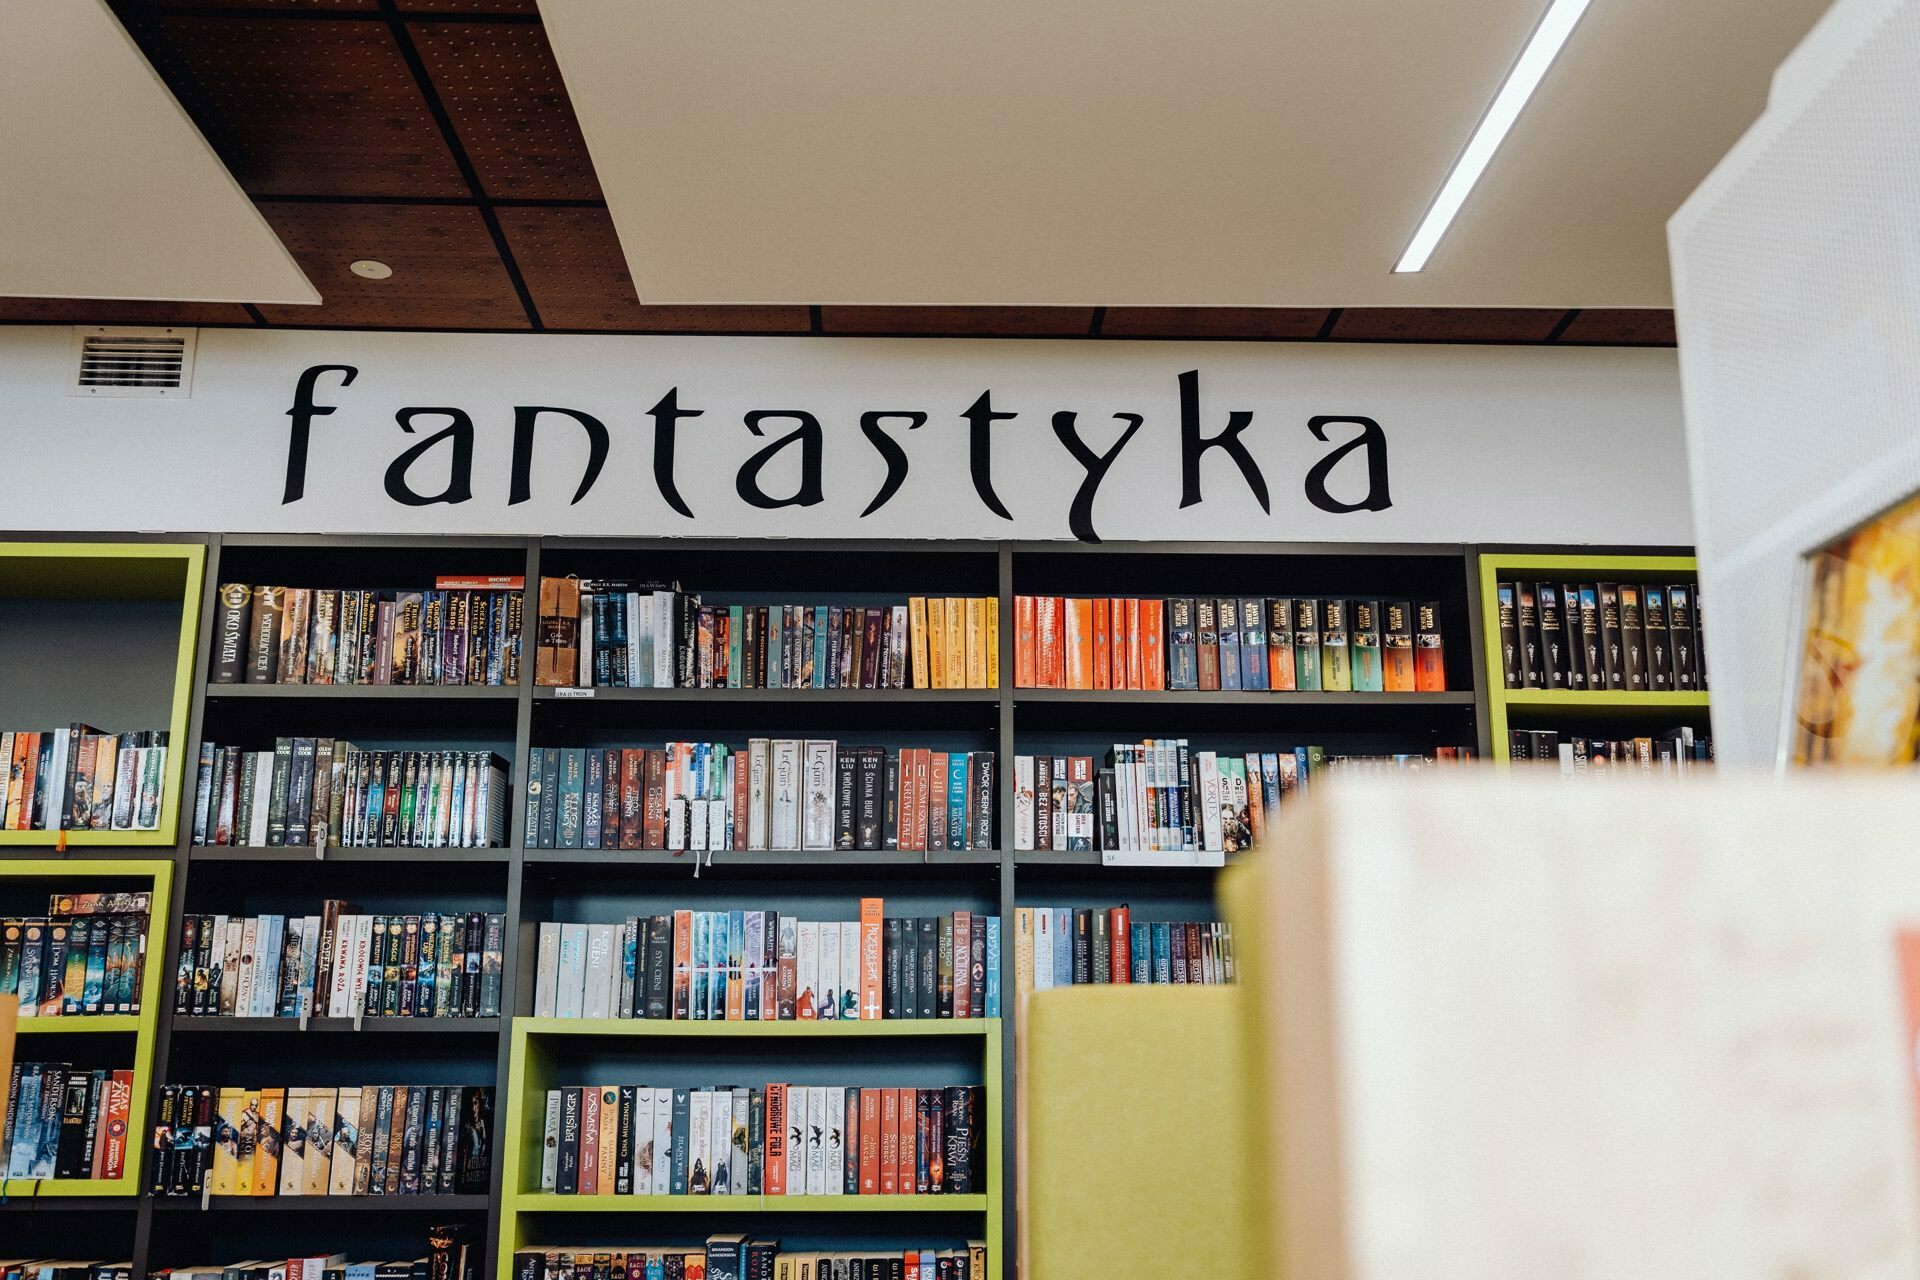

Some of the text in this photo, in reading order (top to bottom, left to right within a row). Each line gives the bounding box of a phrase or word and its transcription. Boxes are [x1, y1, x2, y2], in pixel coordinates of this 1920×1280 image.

[281, 364, 1393, 544] fantastyka
[432, 600, 441, 630] KORONA
[449, 596, 458, 631] NIEBIOS
[457, 600, 466, 627] OGNIE
[472, 595, 481, 636] SZTYLETÓW
[478, 601, 488, 630] ŚCIEŻKA
[222, 610, 241, 663] OKO ŚWIATA
[361, 656, 369, 677] Jordan
[830, 640, 838, 679] PIERWORODNY
[570, 792, 578, 828] KLUCZ
[841, 772, 853, 829] KRÓLOWIE DARY
[864, 772, 876, 818] ŚCIANA BURZ
[903, 781, 912, 811] KREW
[1207, 779, 1218, 822] VORTEX
[1039, 792, 1048, 837] BEZ LITOŚCI
[319, 930, 333, 973] EPOPEJA
[356, 941, 366, 975] KRÓLOWIE
[373, 935, 382, 964] WYRZUTKI
[390, 939, 398, 962] POŚCIG
[945, 937, 952, 946] MA
[988, 925, 997, 970] ERAGON
[49, 947, 61, 1000] DOM HADESA
[336, 939, 348, 992] KRWAWA RÓŻA
[368, 983, 376, 1007] FLANAGAN
[24, 1066, 39, 1138] BRANDON SANDERSON
[48, 1070, 62, 1120] SANDERSON
[109, 1080, 125, 1115] ŻNIW
[120, 1084, 130, 1110] CZAS
[379, 1089, 388, 1120] GROMYKO
[958, 1090, 966, 1120] ANTHONY
[547, 1097, 559, 1133] PIEKARA
[564, 1093, 577, 1142] BRISINGR
[586, 1092, 597, 1144] NAJSTARSZY
[622, 1102, 630, 1137] MILCZENIA
[769, 1086, 782, 1157] CYNOBROWE POLA
[84, 1106, 98, 1162] STALOWE SERCE
[356, 1127, 364, 1160] SZCZURA
[363, 1133, 372, 1154] ROK
[374, 1128, 382, 1158] SZCZURA
[947, 1135, 957, 1166] KRWI
[956, 1128, 969, 1163] PIEŚŃ
[107, 1138, 116, 1171] SHANNON
[600, 1146, 608, 1174] PANNY
[790, 1150, 798, 1172] MAG
[812, 1150, 820, 1172] MAG
[830, 1149, 839, 1171] MAG
